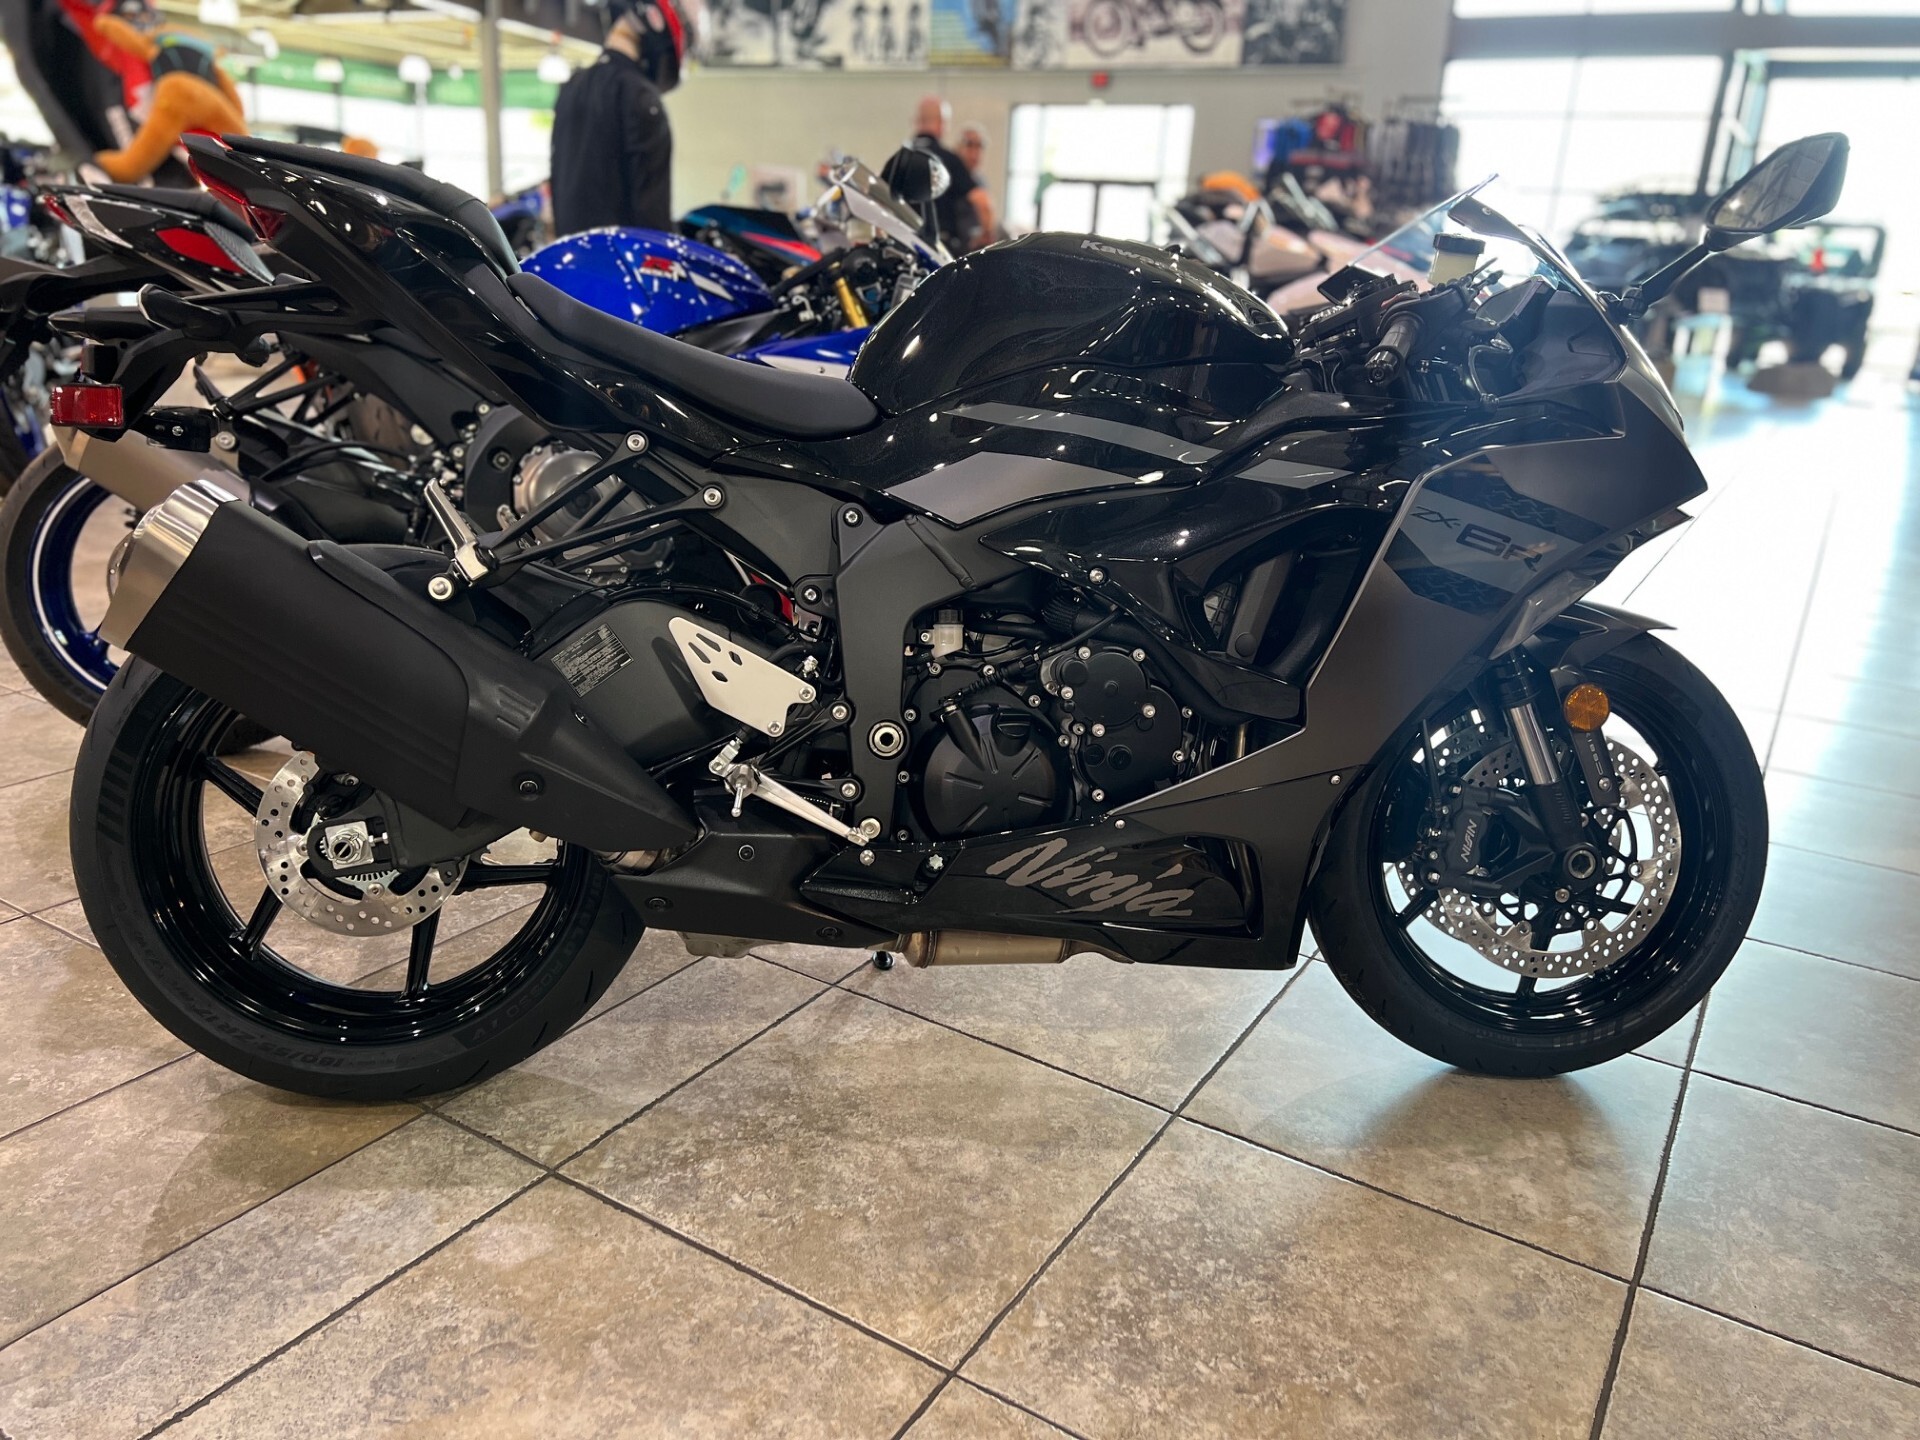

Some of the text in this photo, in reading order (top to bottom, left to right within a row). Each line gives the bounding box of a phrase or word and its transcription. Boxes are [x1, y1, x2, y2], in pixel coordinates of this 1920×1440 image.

[1080, 239, 1199, 281] Kawa
[1461, 818, 1478, 863] NISSIN
[985, 838, 1195, 917] Ninja
